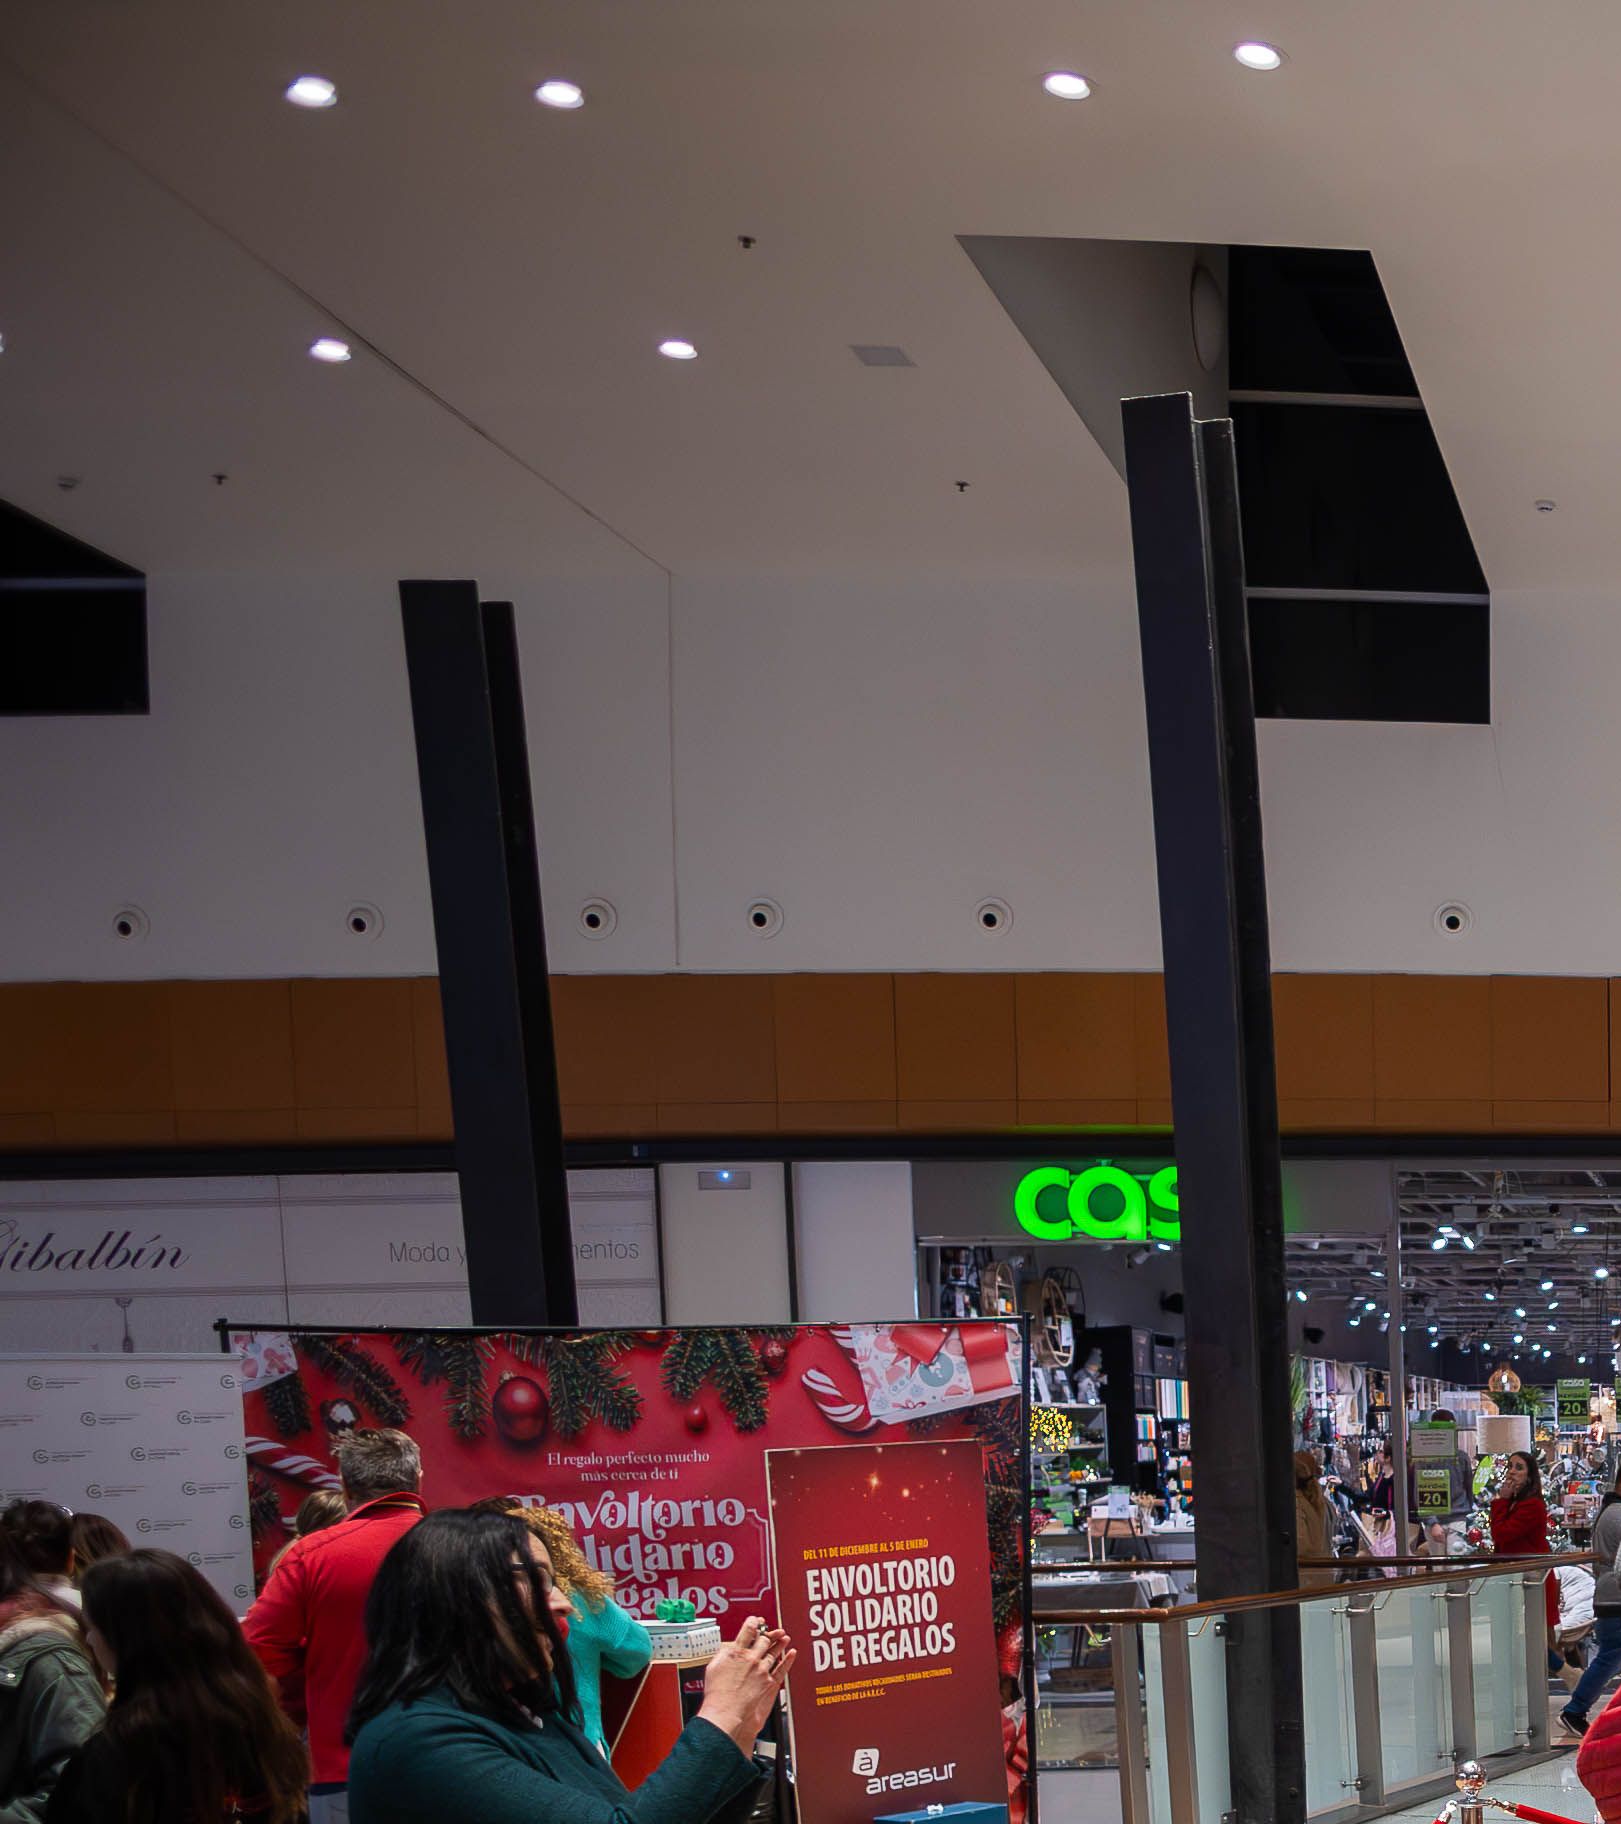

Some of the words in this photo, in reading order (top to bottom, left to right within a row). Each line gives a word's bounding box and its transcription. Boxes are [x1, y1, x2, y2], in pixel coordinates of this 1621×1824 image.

[1014, 1166, 1181, 1241] cas
[0, 1219, 190, 1273] ibalbín
[389, 1241, 450, 1263] Moda
[548, 1452, 561, 1466] El
[563, 1452, 603, 1468] regalo
[606, 1451, 662, 1468] perfecto
[665, 1450, 710, 1464] mucho
[610, 1471, 647, 1481] cerca
[650, 1467, 666, 1480] de
[669, 1467, 679, 1480] ti
[583, 1533, 735, 1585] lidario
[803, 1549, 817, 1560] DEL
[818, 1549, 828, 1558] 11
[829, 1547, 839, 1558] DE
[840, 1543, 878, 1557] DICIEMBRE
[879, 1542, 888, 1552] AL
[889, 1541, 895, 1551] 5
[895, 1540, 904, 1550] DE
[905, 1538, 928, 1549] ENERO
[615, 1577, 730, 1620] galos
[806, 1555, 955, 1602] ENVOLTORIO
[809, 1591, 938, 1637] SOLIDARIO
[813, 1637, 846, 1672] DE
[851, 1622, 956, 1667] REGALOS
[866, 1763, 956, 1795] areasur
